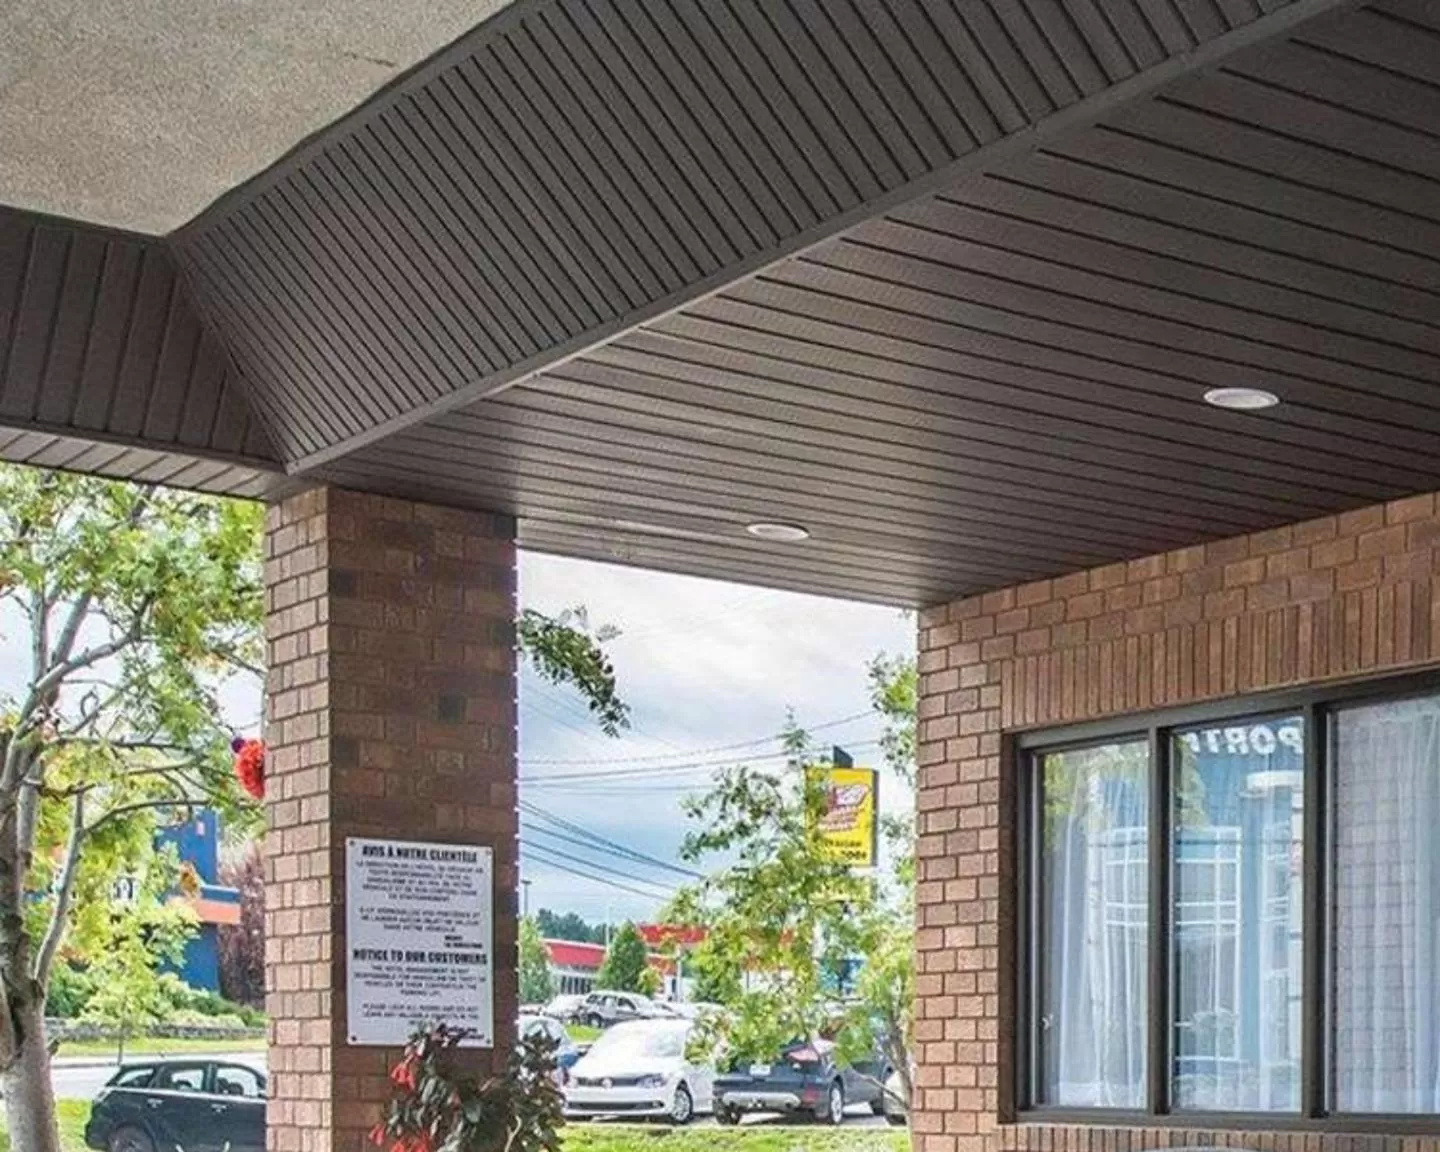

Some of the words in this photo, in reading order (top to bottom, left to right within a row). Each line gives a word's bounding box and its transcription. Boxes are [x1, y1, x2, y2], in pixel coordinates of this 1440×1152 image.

[396, 847, 427, 860] NOTRE
[353, 949, 388, 961] NOTICE
[390, 950, 404, 961] TO
[405, 951, 425, 962] OUR
[428, 951, 487, 965] CUSTOMERS
